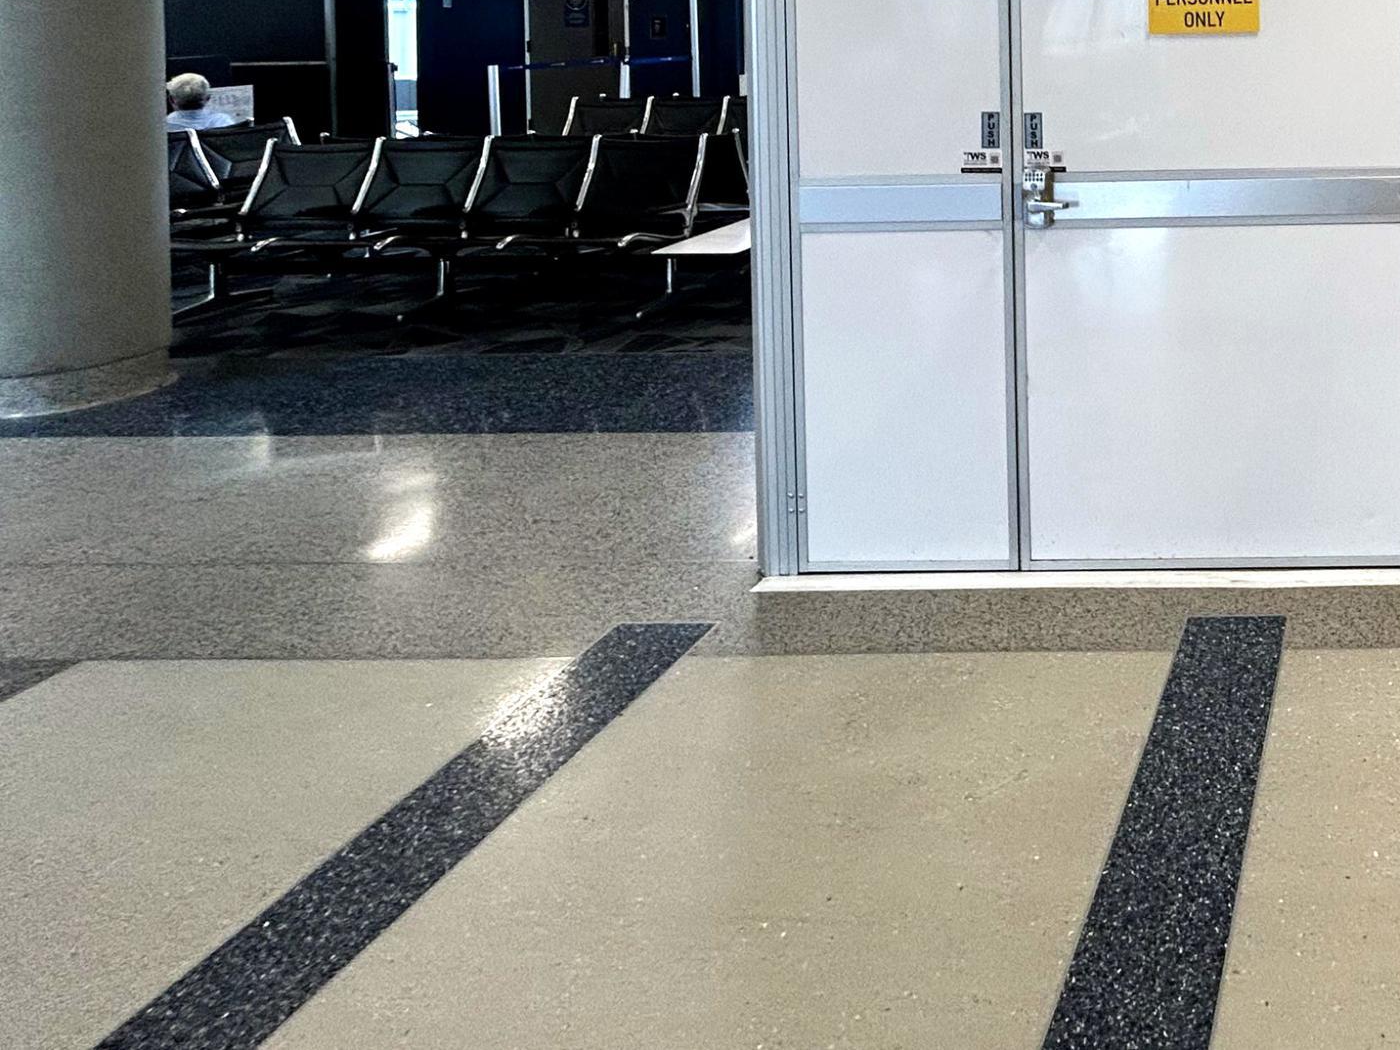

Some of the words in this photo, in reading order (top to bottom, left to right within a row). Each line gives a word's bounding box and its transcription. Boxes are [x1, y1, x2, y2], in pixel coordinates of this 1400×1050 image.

[1184, 11, 1225, 27] ONLY
[987, 113, 996, 147] PUSH
[1029, 114, 1039, 148] PUSH
[963, 151, 987, 161] TWS
[1026, 150, 1050, 160] TWS
